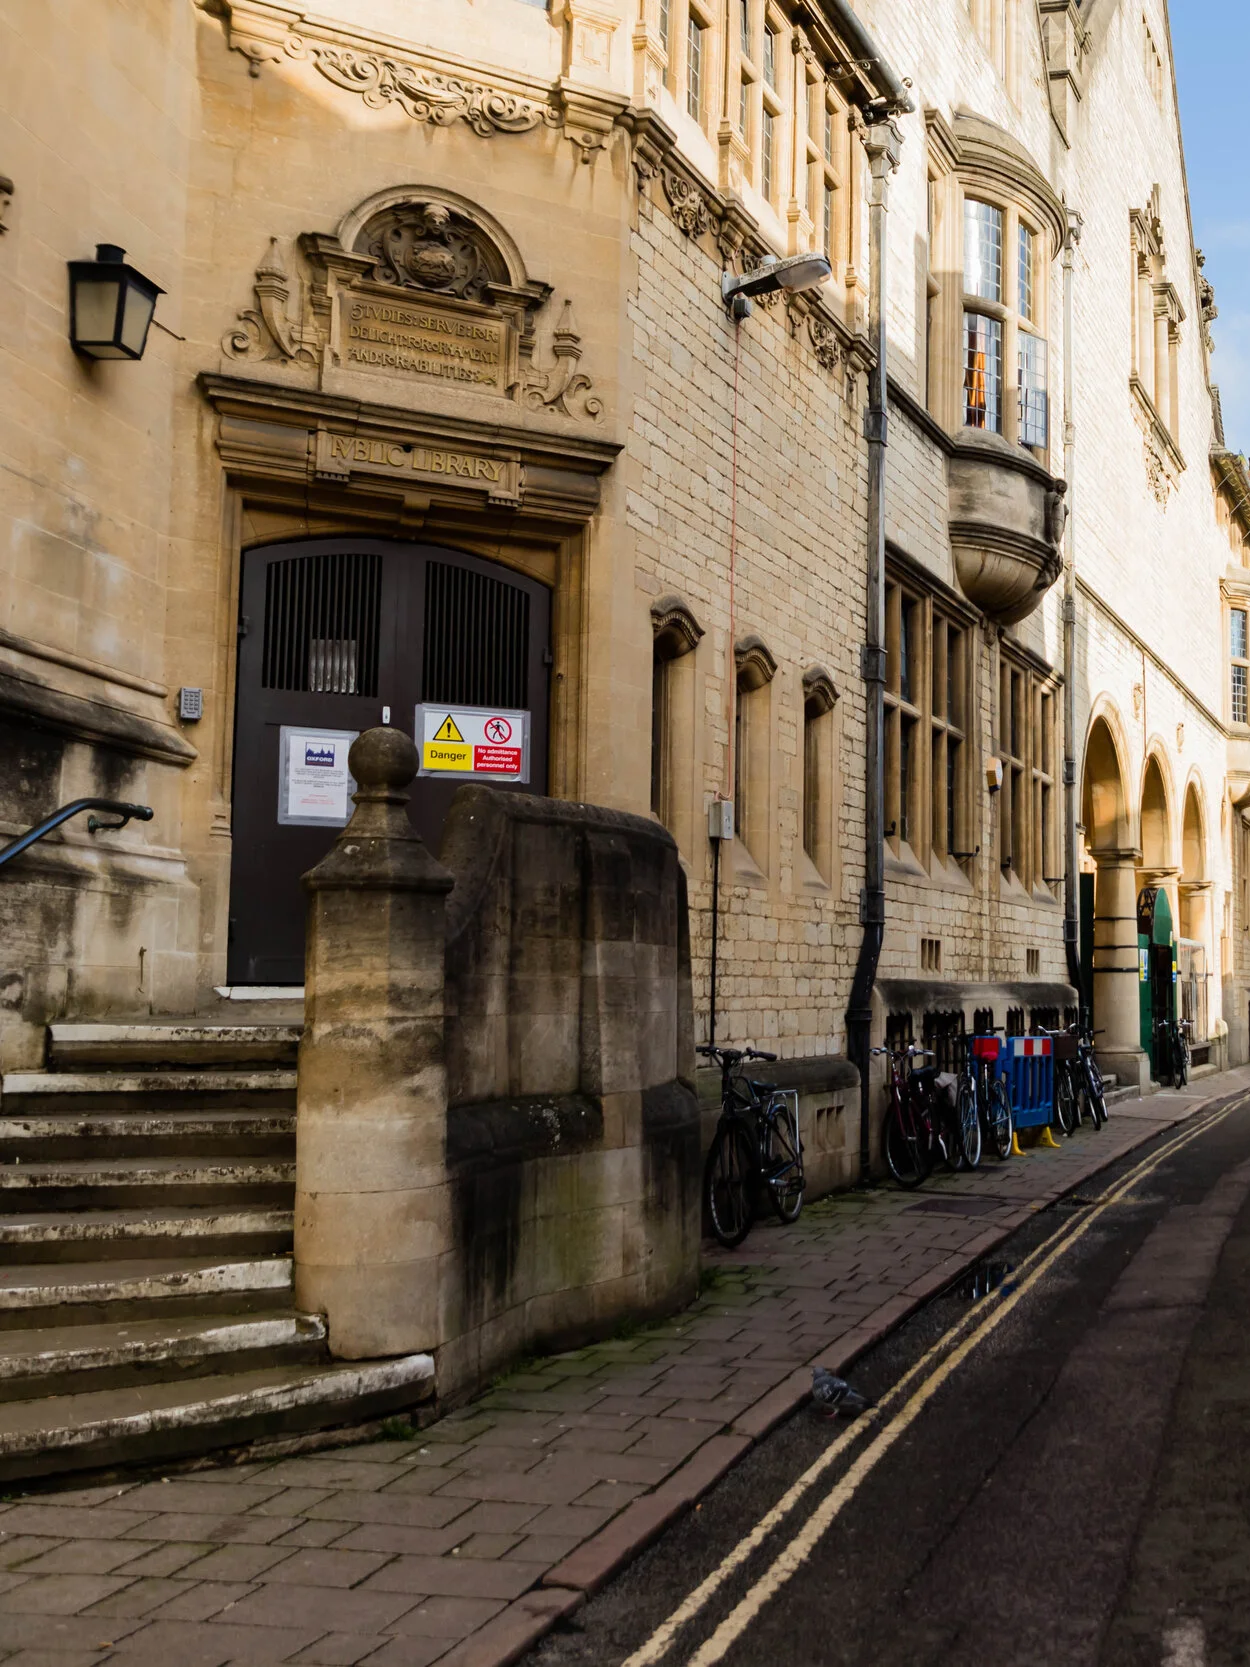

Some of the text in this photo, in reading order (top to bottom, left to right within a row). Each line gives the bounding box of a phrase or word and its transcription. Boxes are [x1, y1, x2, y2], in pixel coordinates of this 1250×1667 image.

[412, 448, 506, 482] LIBRARY
[430, 750, 467, 761] Danger
[487, 748, 518, 756] admittance
